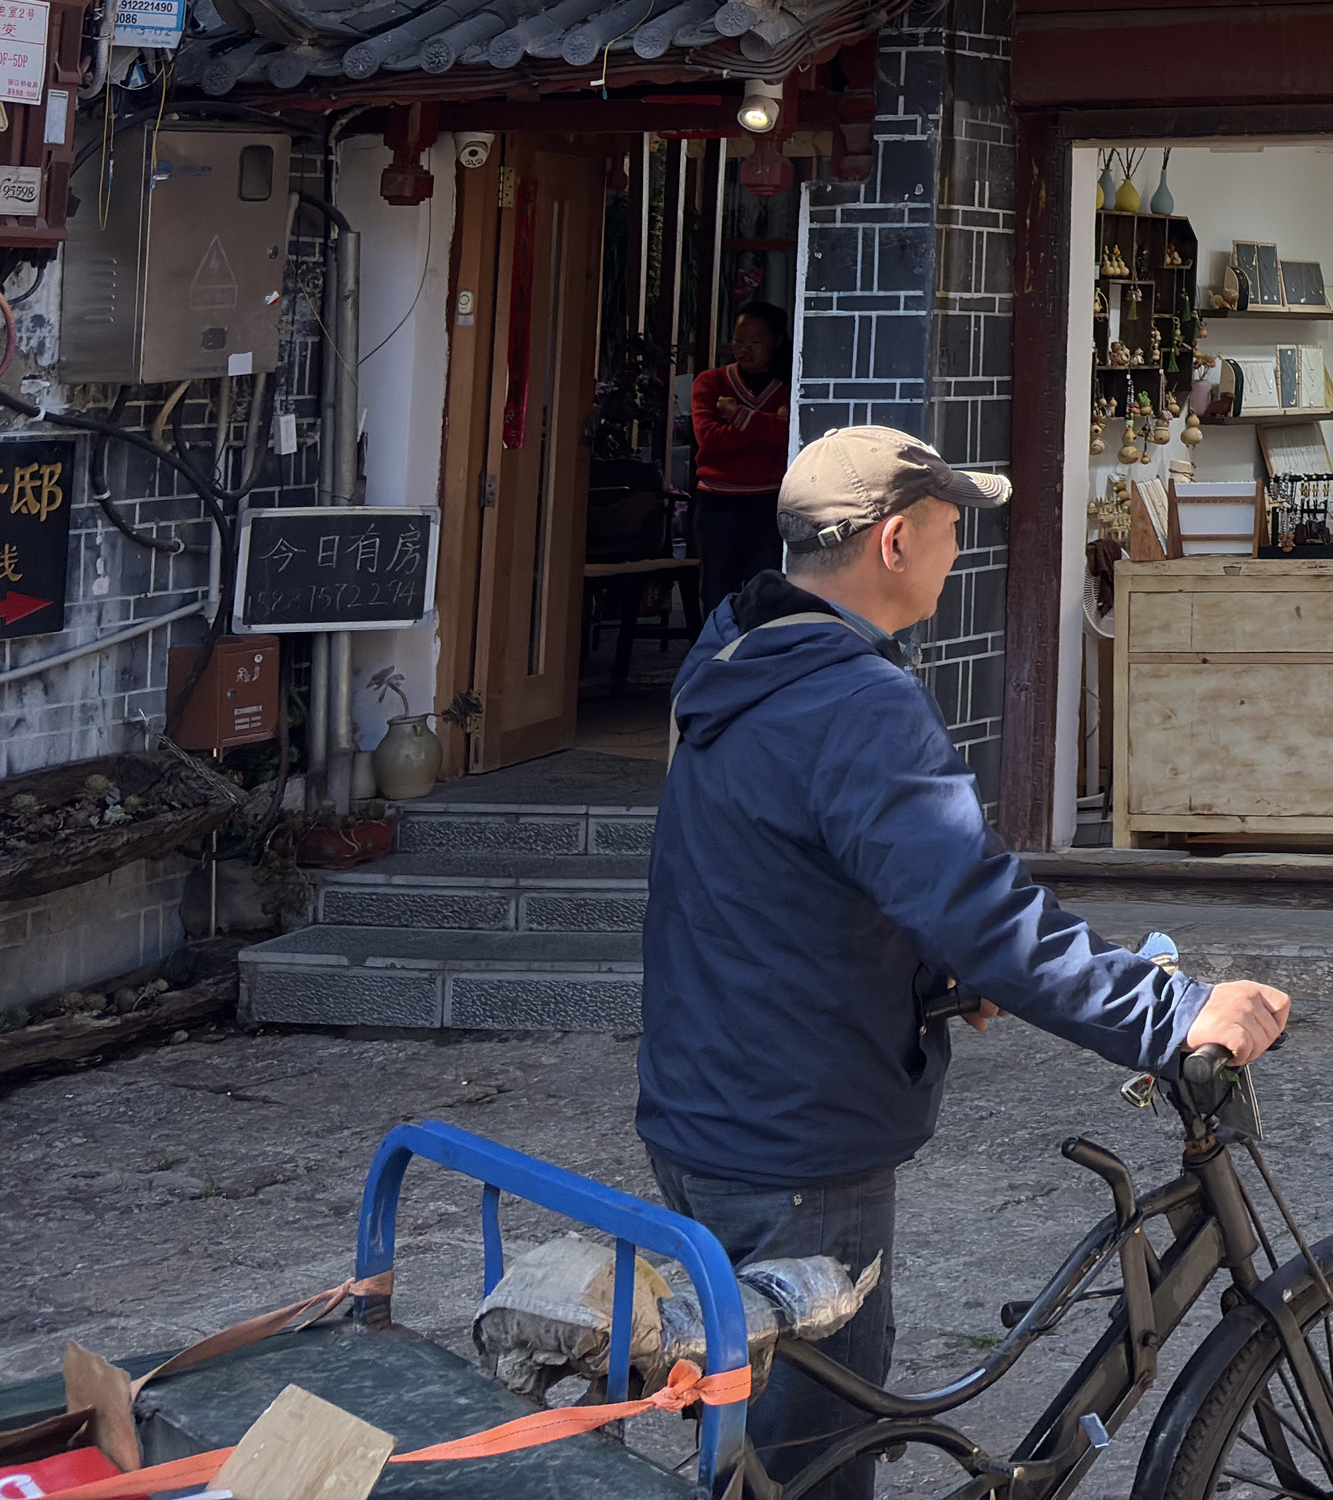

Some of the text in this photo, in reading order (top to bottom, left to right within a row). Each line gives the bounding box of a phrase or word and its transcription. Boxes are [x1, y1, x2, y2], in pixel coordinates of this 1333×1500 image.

[119, 0, 173, 12] 912221490
[259, 523, 422, 575] 今日有房
